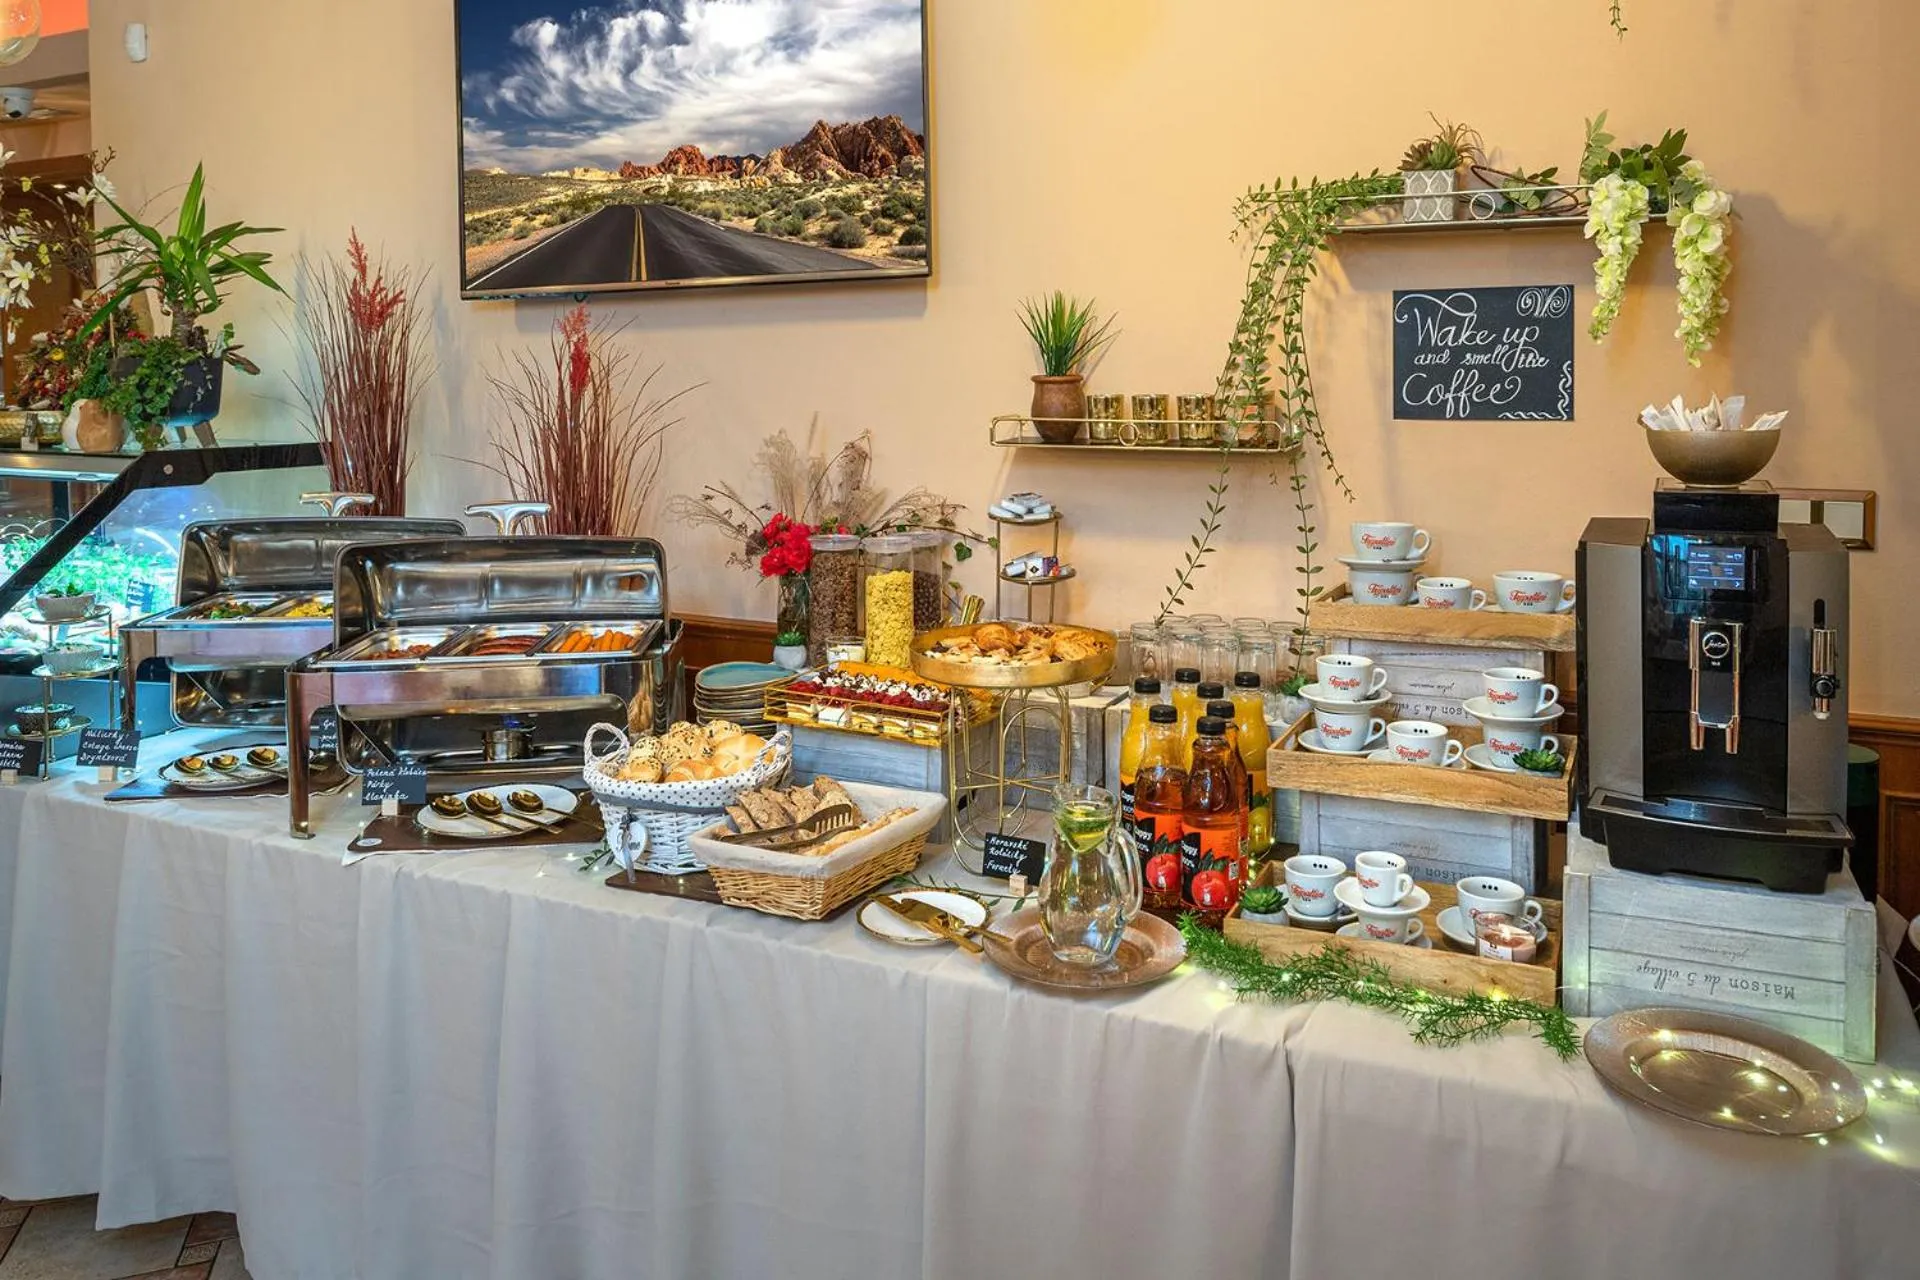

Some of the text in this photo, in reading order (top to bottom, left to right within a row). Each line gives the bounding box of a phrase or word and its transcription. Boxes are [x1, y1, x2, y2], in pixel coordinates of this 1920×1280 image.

[1400, 295, 1540, 368] Wake up
[1414, 344, 1549, 369] and smell the
[1403, 368, 1521, 419] Coffee
[1635, 960, 1796, 1000] Maison du 5 village
